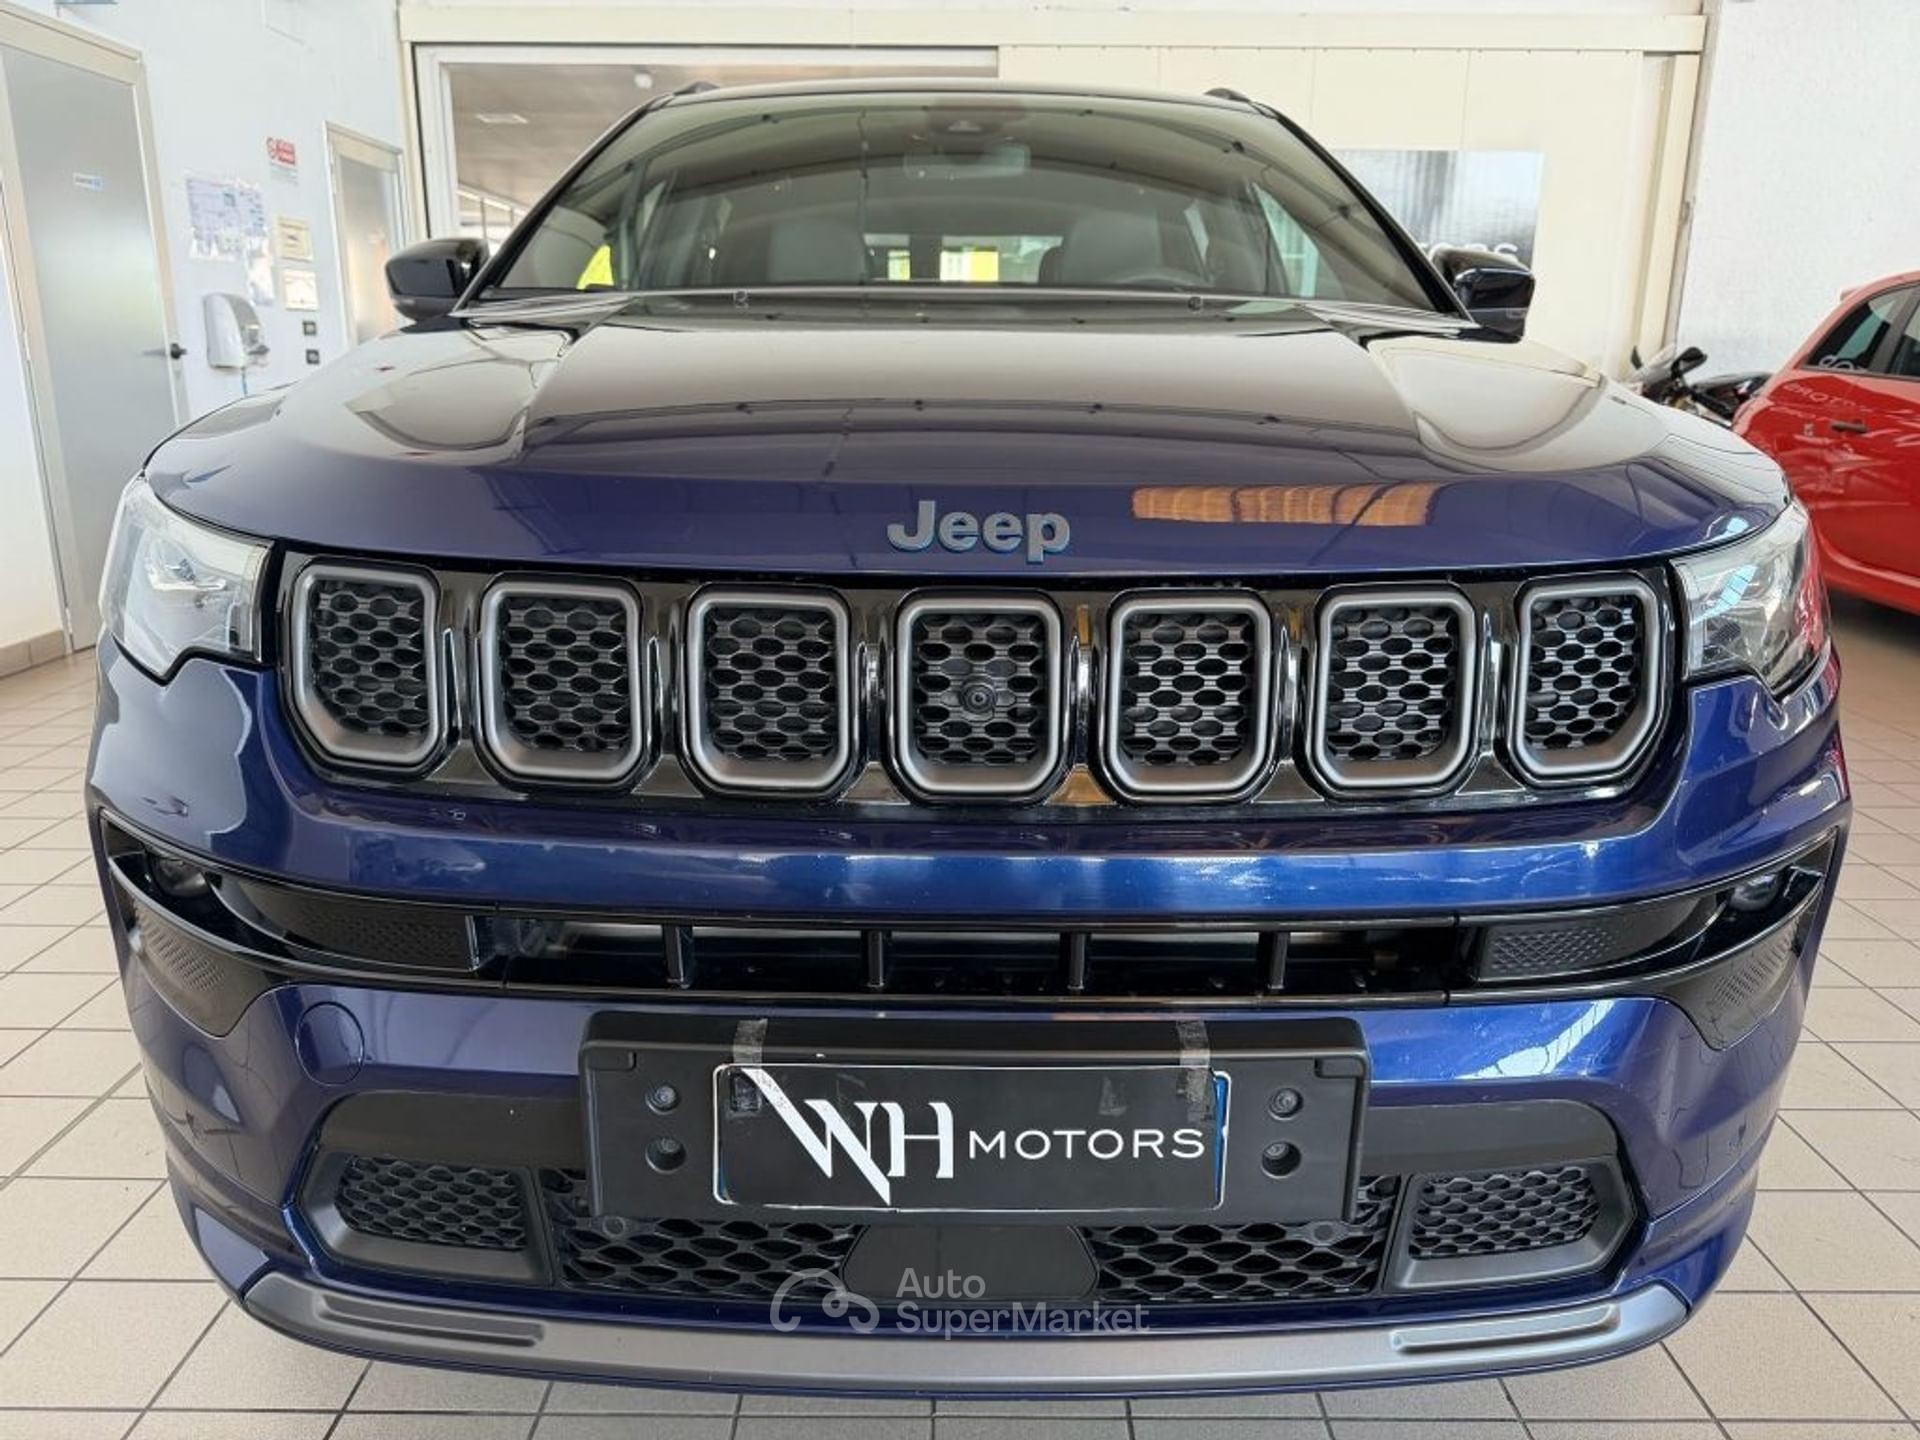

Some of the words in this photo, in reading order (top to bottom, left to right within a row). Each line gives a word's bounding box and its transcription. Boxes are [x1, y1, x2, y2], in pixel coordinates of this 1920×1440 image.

[887, 500, 1070, 565] Jeep
[741, 1067, 954, 1206] WH
[968, 1129, 1206, 1160] MOTORS
